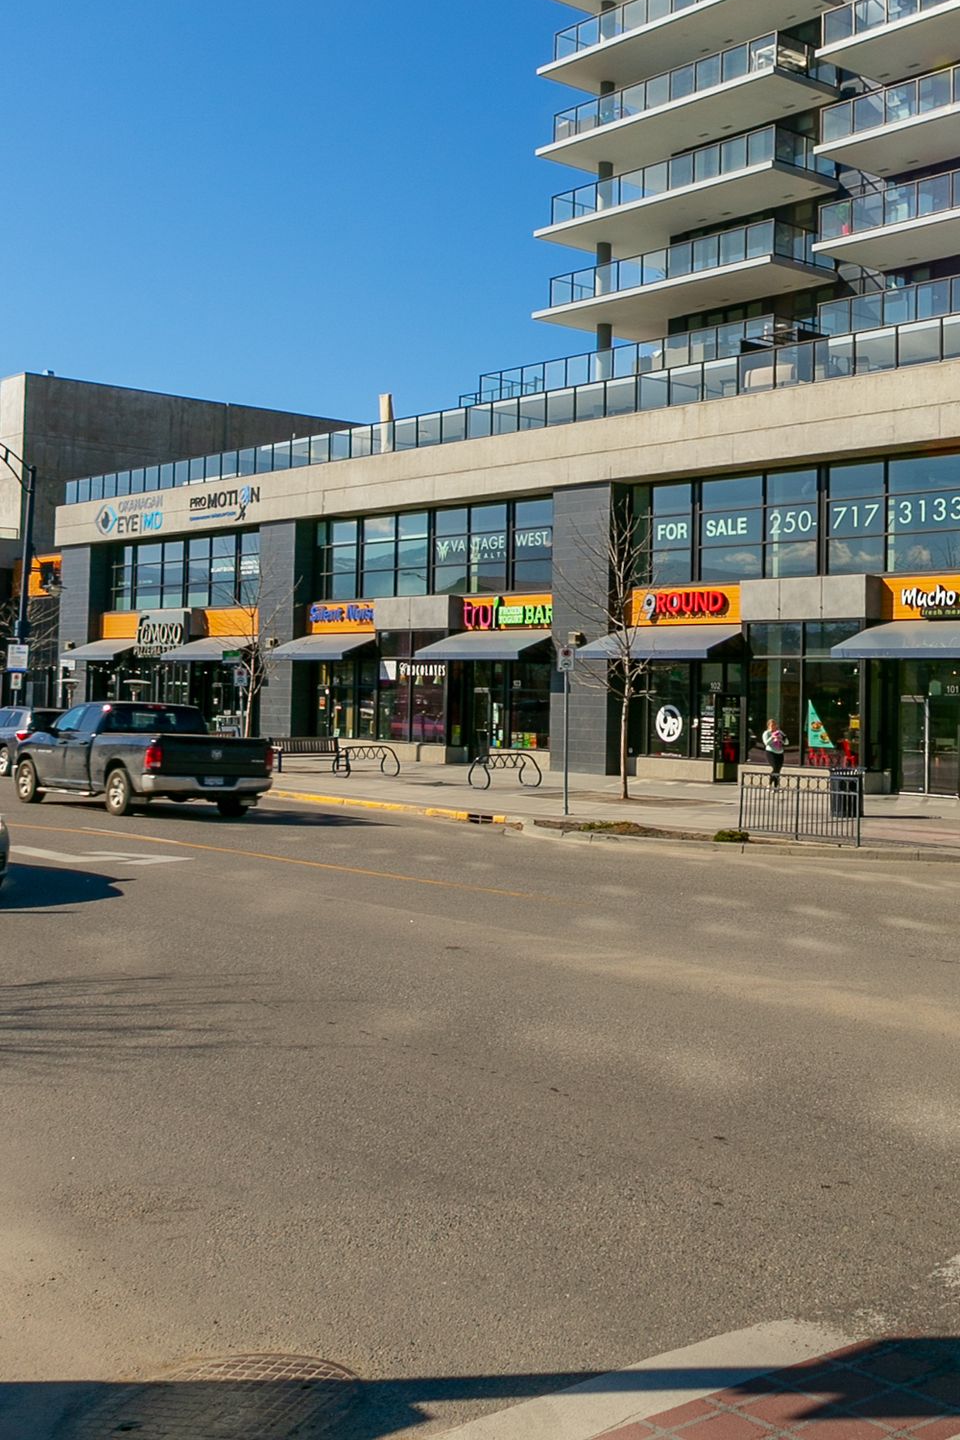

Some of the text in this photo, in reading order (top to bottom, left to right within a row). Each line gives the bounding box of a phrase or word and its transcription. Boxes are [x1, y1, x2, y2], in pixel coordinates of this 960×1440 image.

[118, 495, 163, 513] OKANAGAN
[657, 522, 688, 541] FOR
[706, 517, 748, 537] SALE
[515, 531, 548, 547] WEST
[310, 605, 345, 623] Silent
[525, 605, 552, 624] BAR
[710, 682, 720, 690] 102
[946, 685, 959, 694] 101
